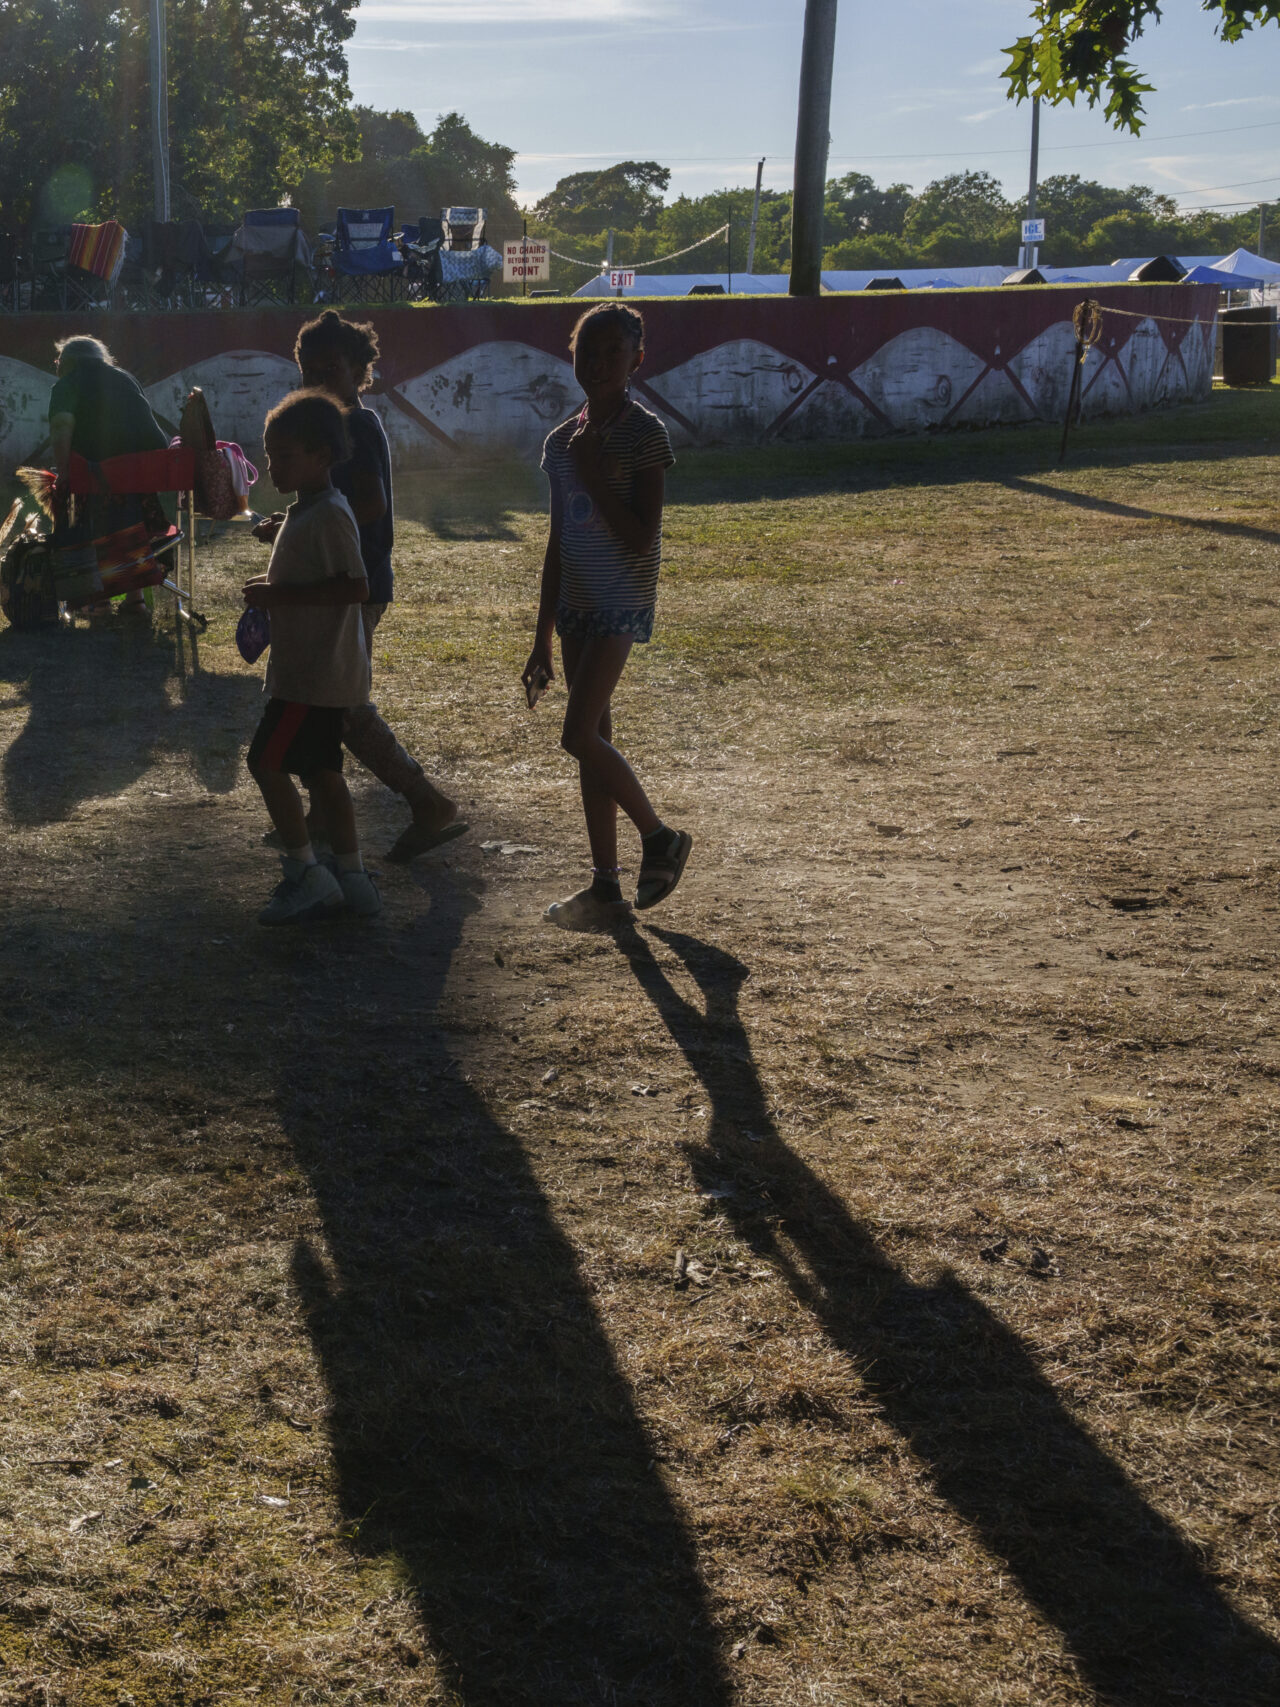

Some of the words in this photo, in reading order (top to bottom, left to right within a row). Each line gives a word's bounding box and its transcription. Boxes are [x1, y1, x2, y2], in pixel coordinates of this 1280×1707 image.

[1024, 223, 1041, 234] ICE
[507, 246, 516, 255] NO
[519, 245, 546, 254] CHAIRS
[508, 256, 529, 264] BEYOND
[512, 266, 540, 276] POINT
[611, 274, 634, 286] EXIT
